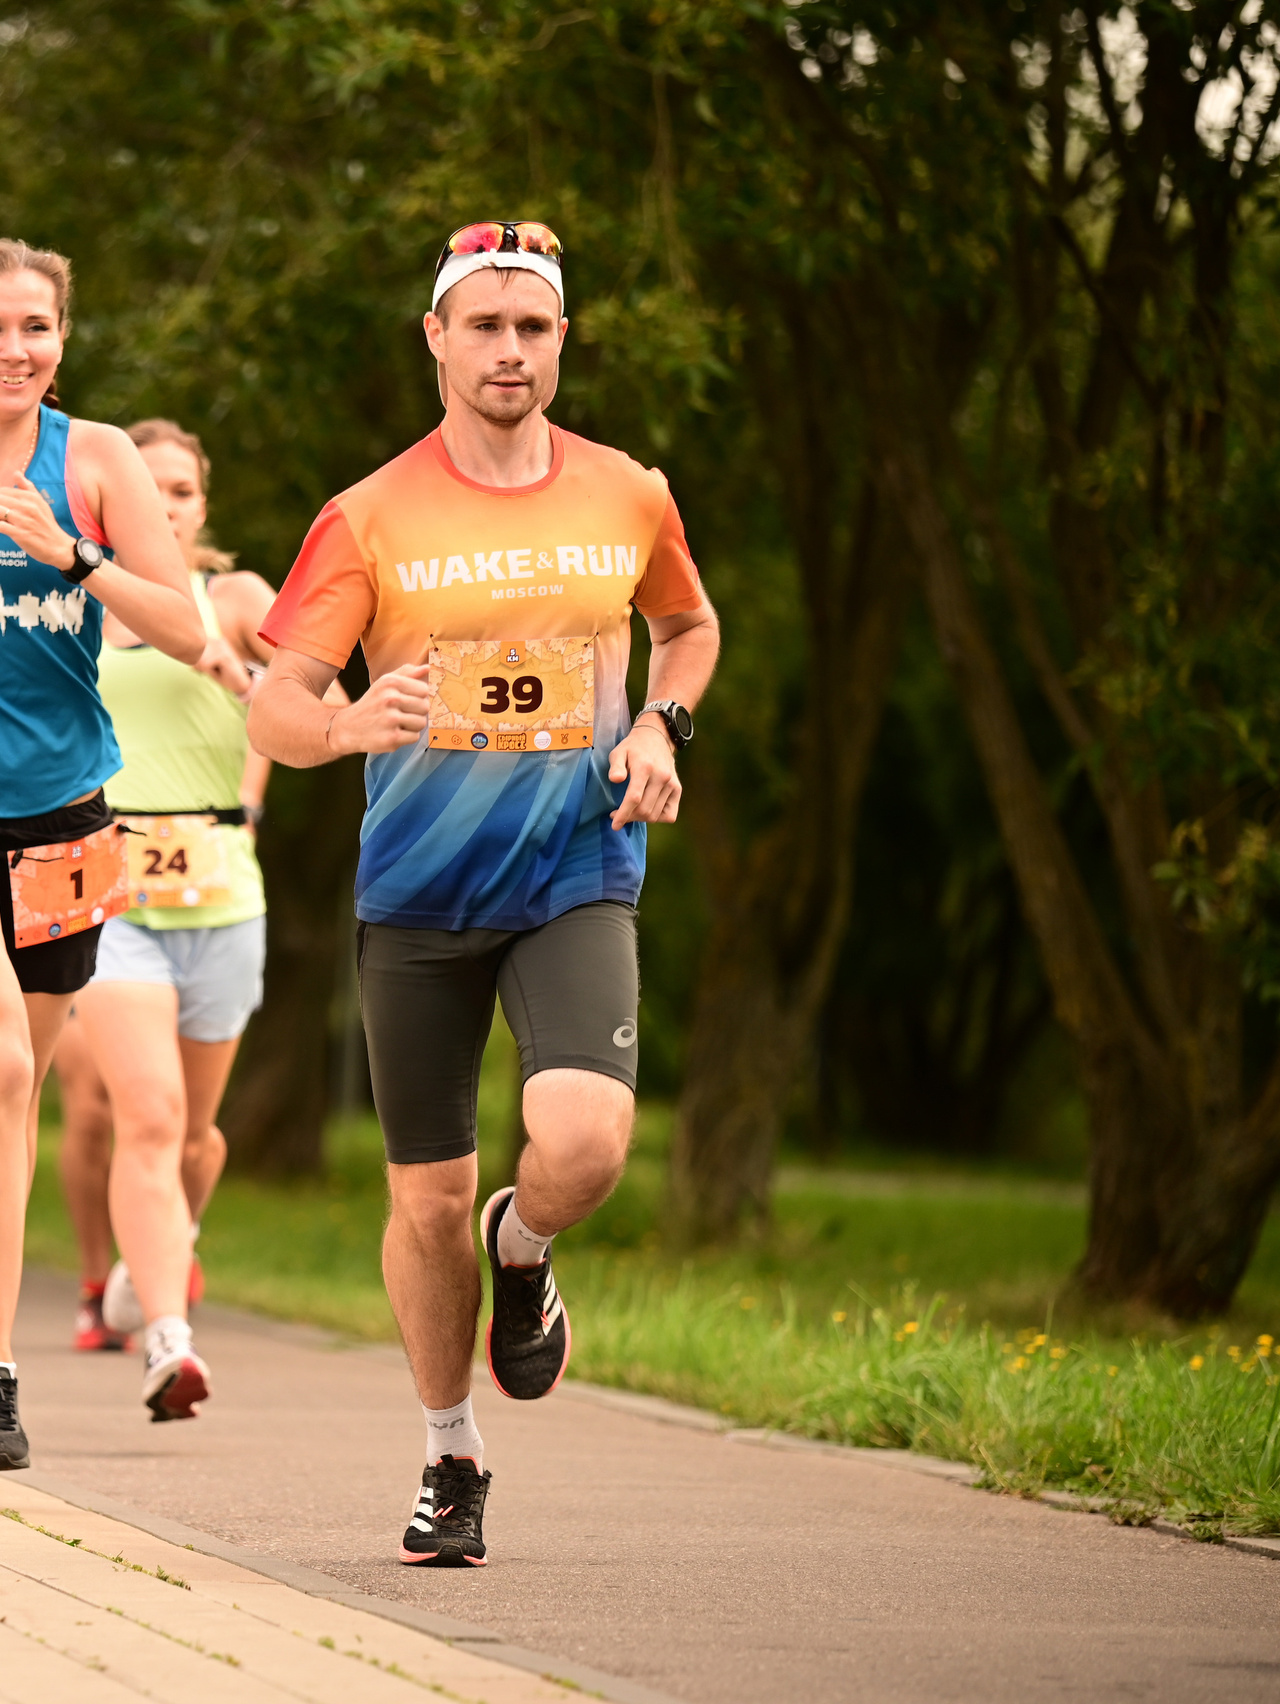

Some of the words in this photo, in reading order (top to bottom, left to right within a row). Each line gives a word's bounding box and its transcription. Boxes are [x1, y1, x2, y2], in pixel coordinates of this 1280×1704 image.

[396, 548, 534, 592] WAKE
[536, 551, 555, 569] &
[556, 545, 637, 577] RUN
[491, 584, 564, 600] MOSCOW
[510, 648, 517, 656] 5
[480, 675, 544, 714] 39
[144, 848, 188, 875] 24
[70, 868, 83, 900] 1
